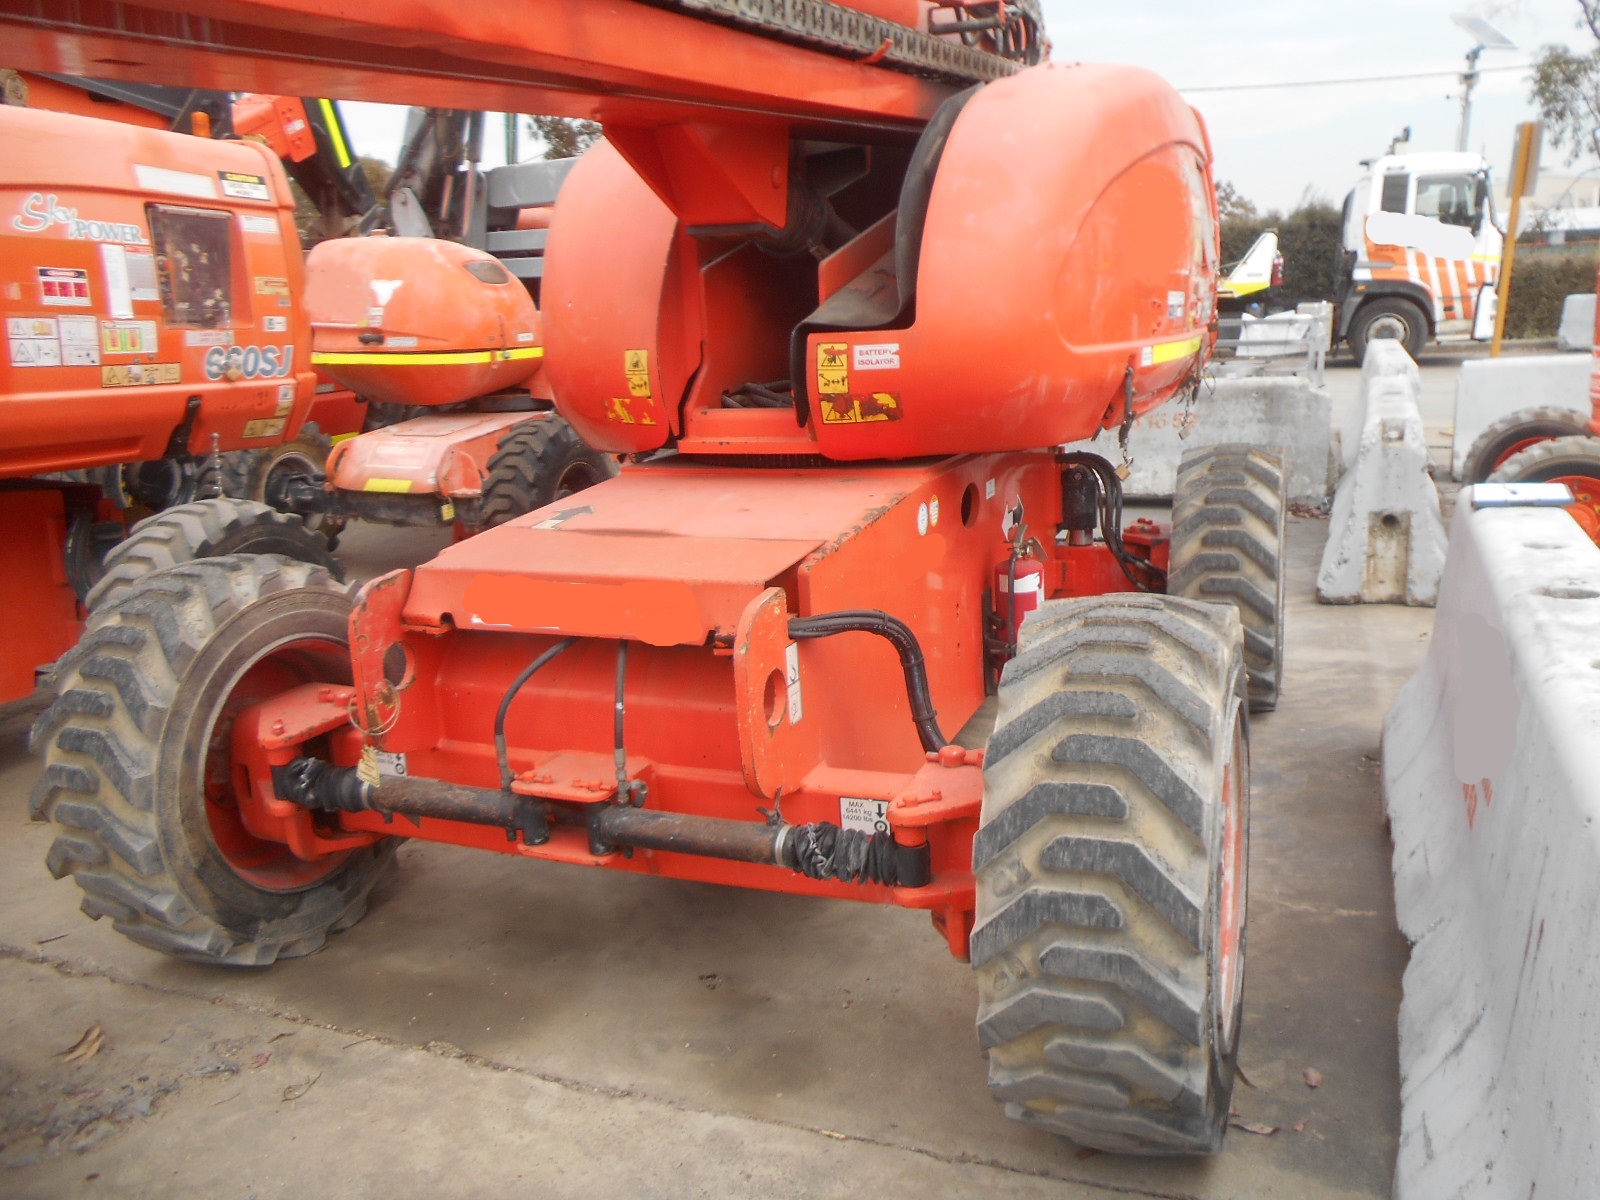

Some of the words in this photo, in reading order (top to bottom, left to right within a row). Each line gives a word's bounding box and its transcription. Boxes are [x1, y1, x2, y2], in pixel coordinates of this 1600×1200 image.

[12, 192, 77, 239] Sky
[73, 220, 147, 243] POWER
[857, 357, 895, 366] ISOLATOR
[848, 800, 864, 808] MAX
[863, 809, 873, 817] kg
[842, 813, 862, 822] 14200
[863, 815, 874, 823] lbs
